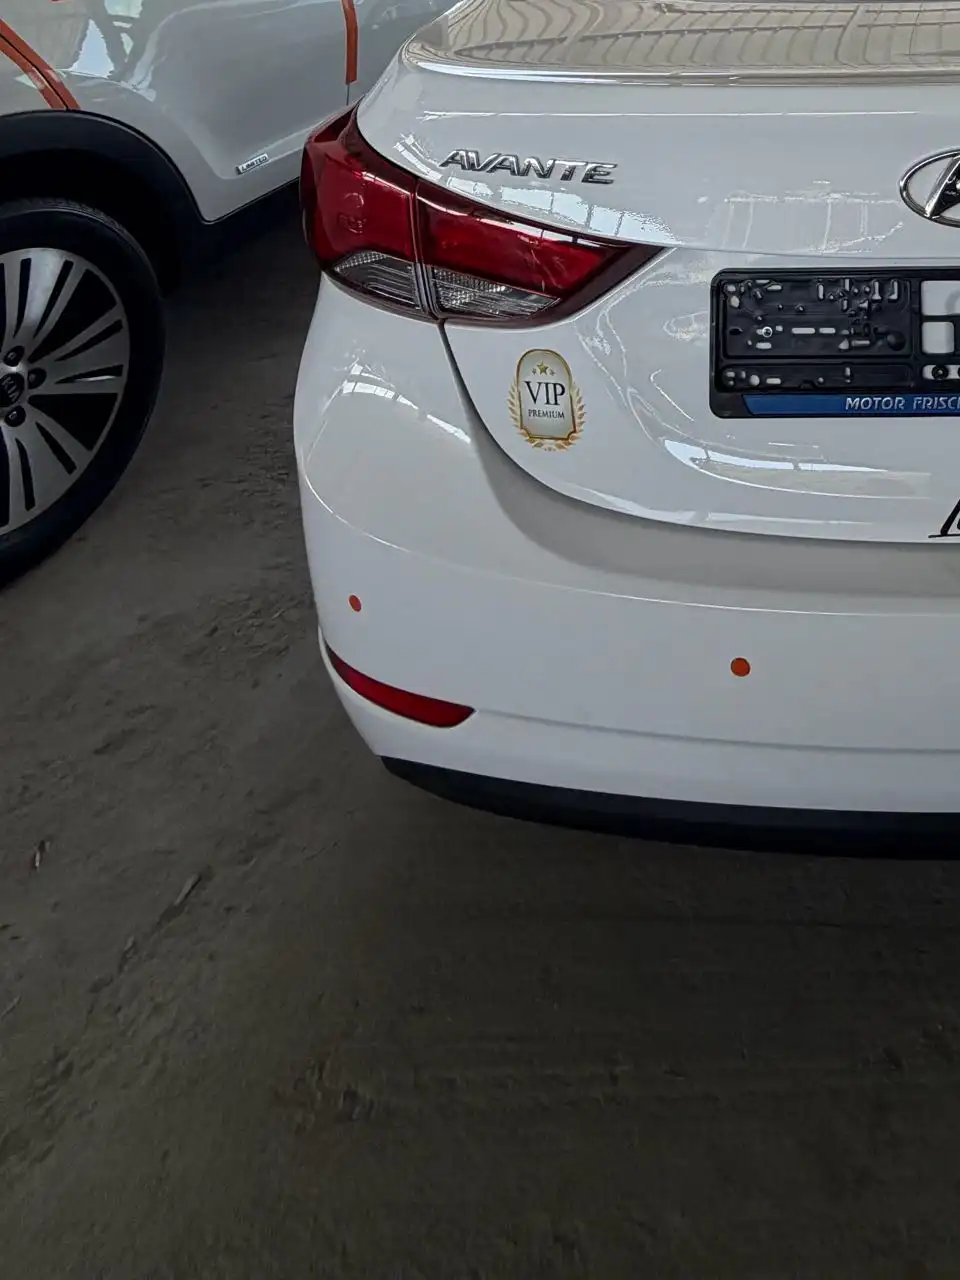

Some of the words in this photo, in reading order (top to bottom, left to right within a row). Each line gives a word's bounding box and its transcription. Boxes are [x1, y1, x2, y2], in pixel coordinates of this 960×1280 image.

[437, 148, 619, 185] AVANTE
[523, 380, 566, 406] VIP
[845, 396, 906, 410] MOTOR
[527, 408, 566, 420] PREMIUM
